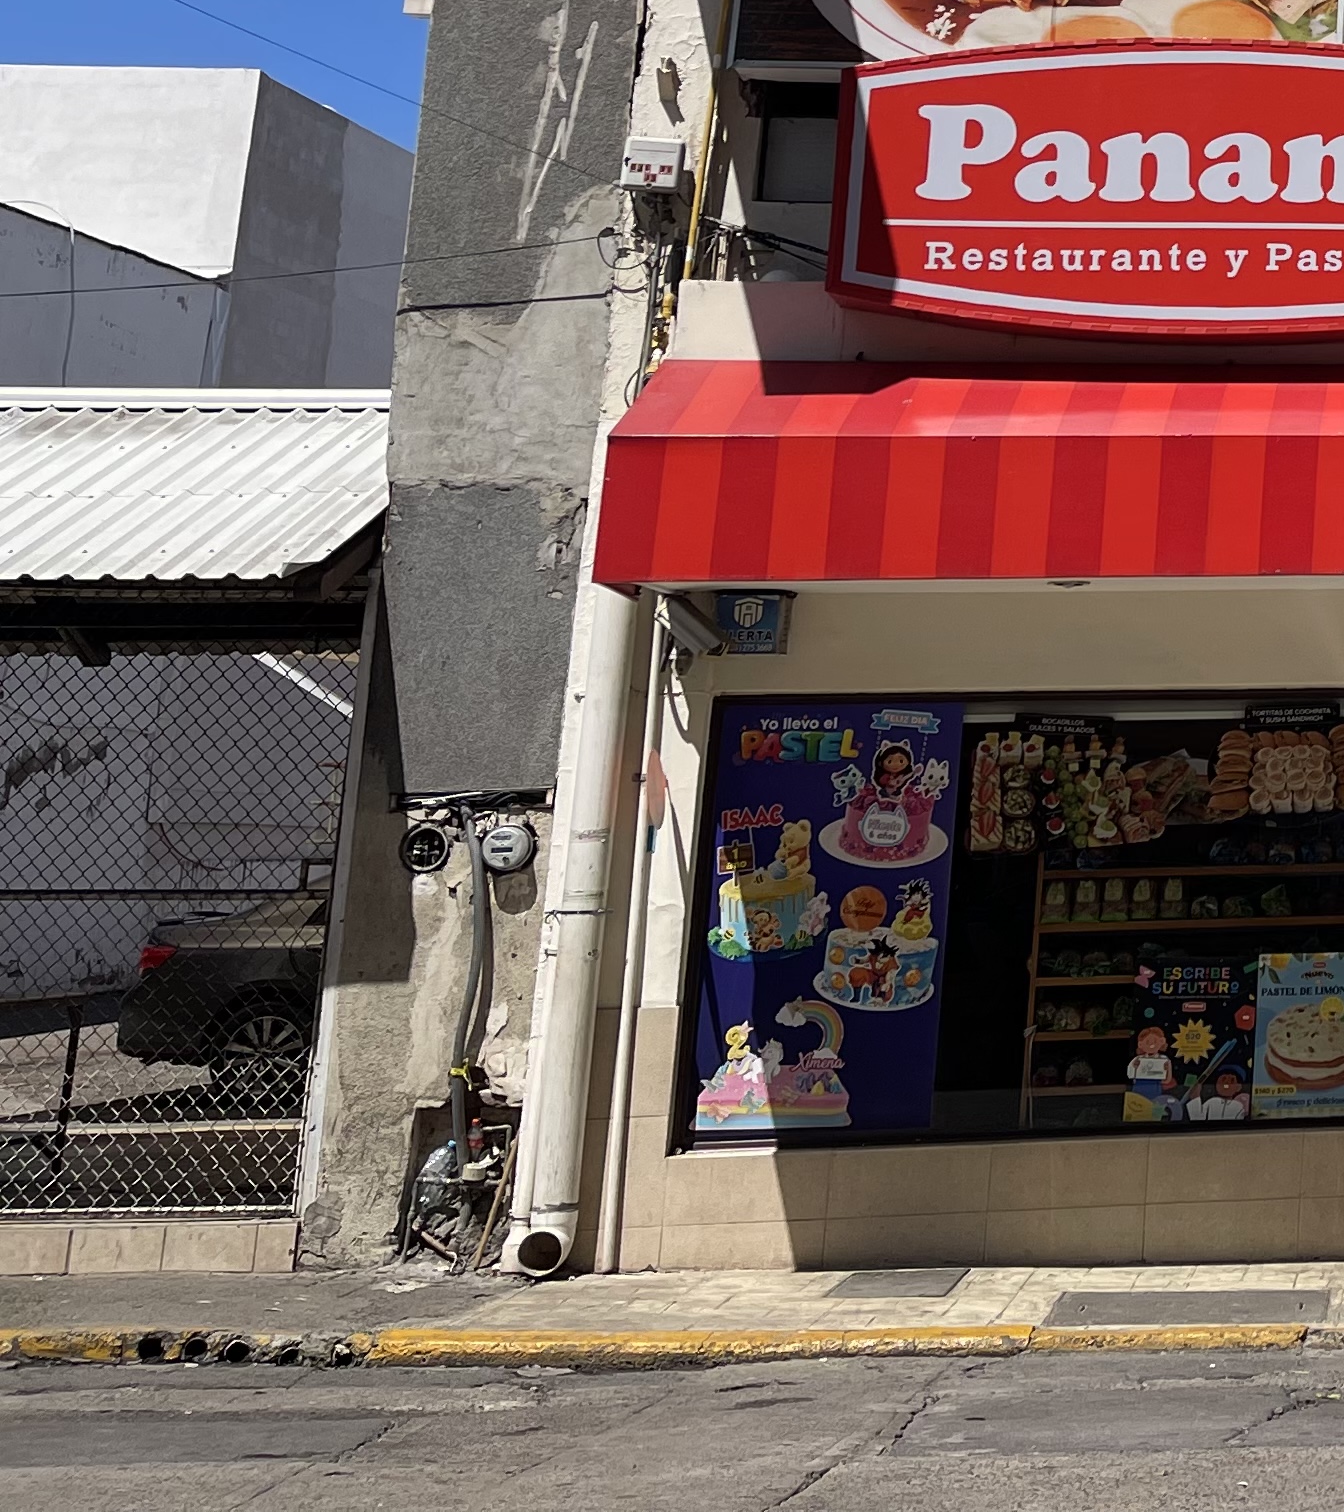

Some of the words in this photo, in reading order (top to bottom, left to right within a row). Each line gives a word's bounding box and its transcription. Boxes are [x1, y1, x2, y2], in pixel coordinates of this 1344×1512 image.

[924, 240, 1208, 272] Restaurante
[1225, 251, 1245, 278] y
[760, 717, 779, 731] Yo
[783, 717, 819, 730] llevo
[824, 716, 839, 729] el
[883, 714, 910, 726] FELIZ
[740, 728, 860, 764] PASTEL
[721, 803, 784, 832] ISAAC
[1163, 966, 1231, 981] ESCRIBE
[1152, 981, 1174, 994] SU
[1261, 988, 1297, 996] PASTEL
[1300, 987, 1312, 995] DE
[790, 1051, 845, 1072] Ximena
